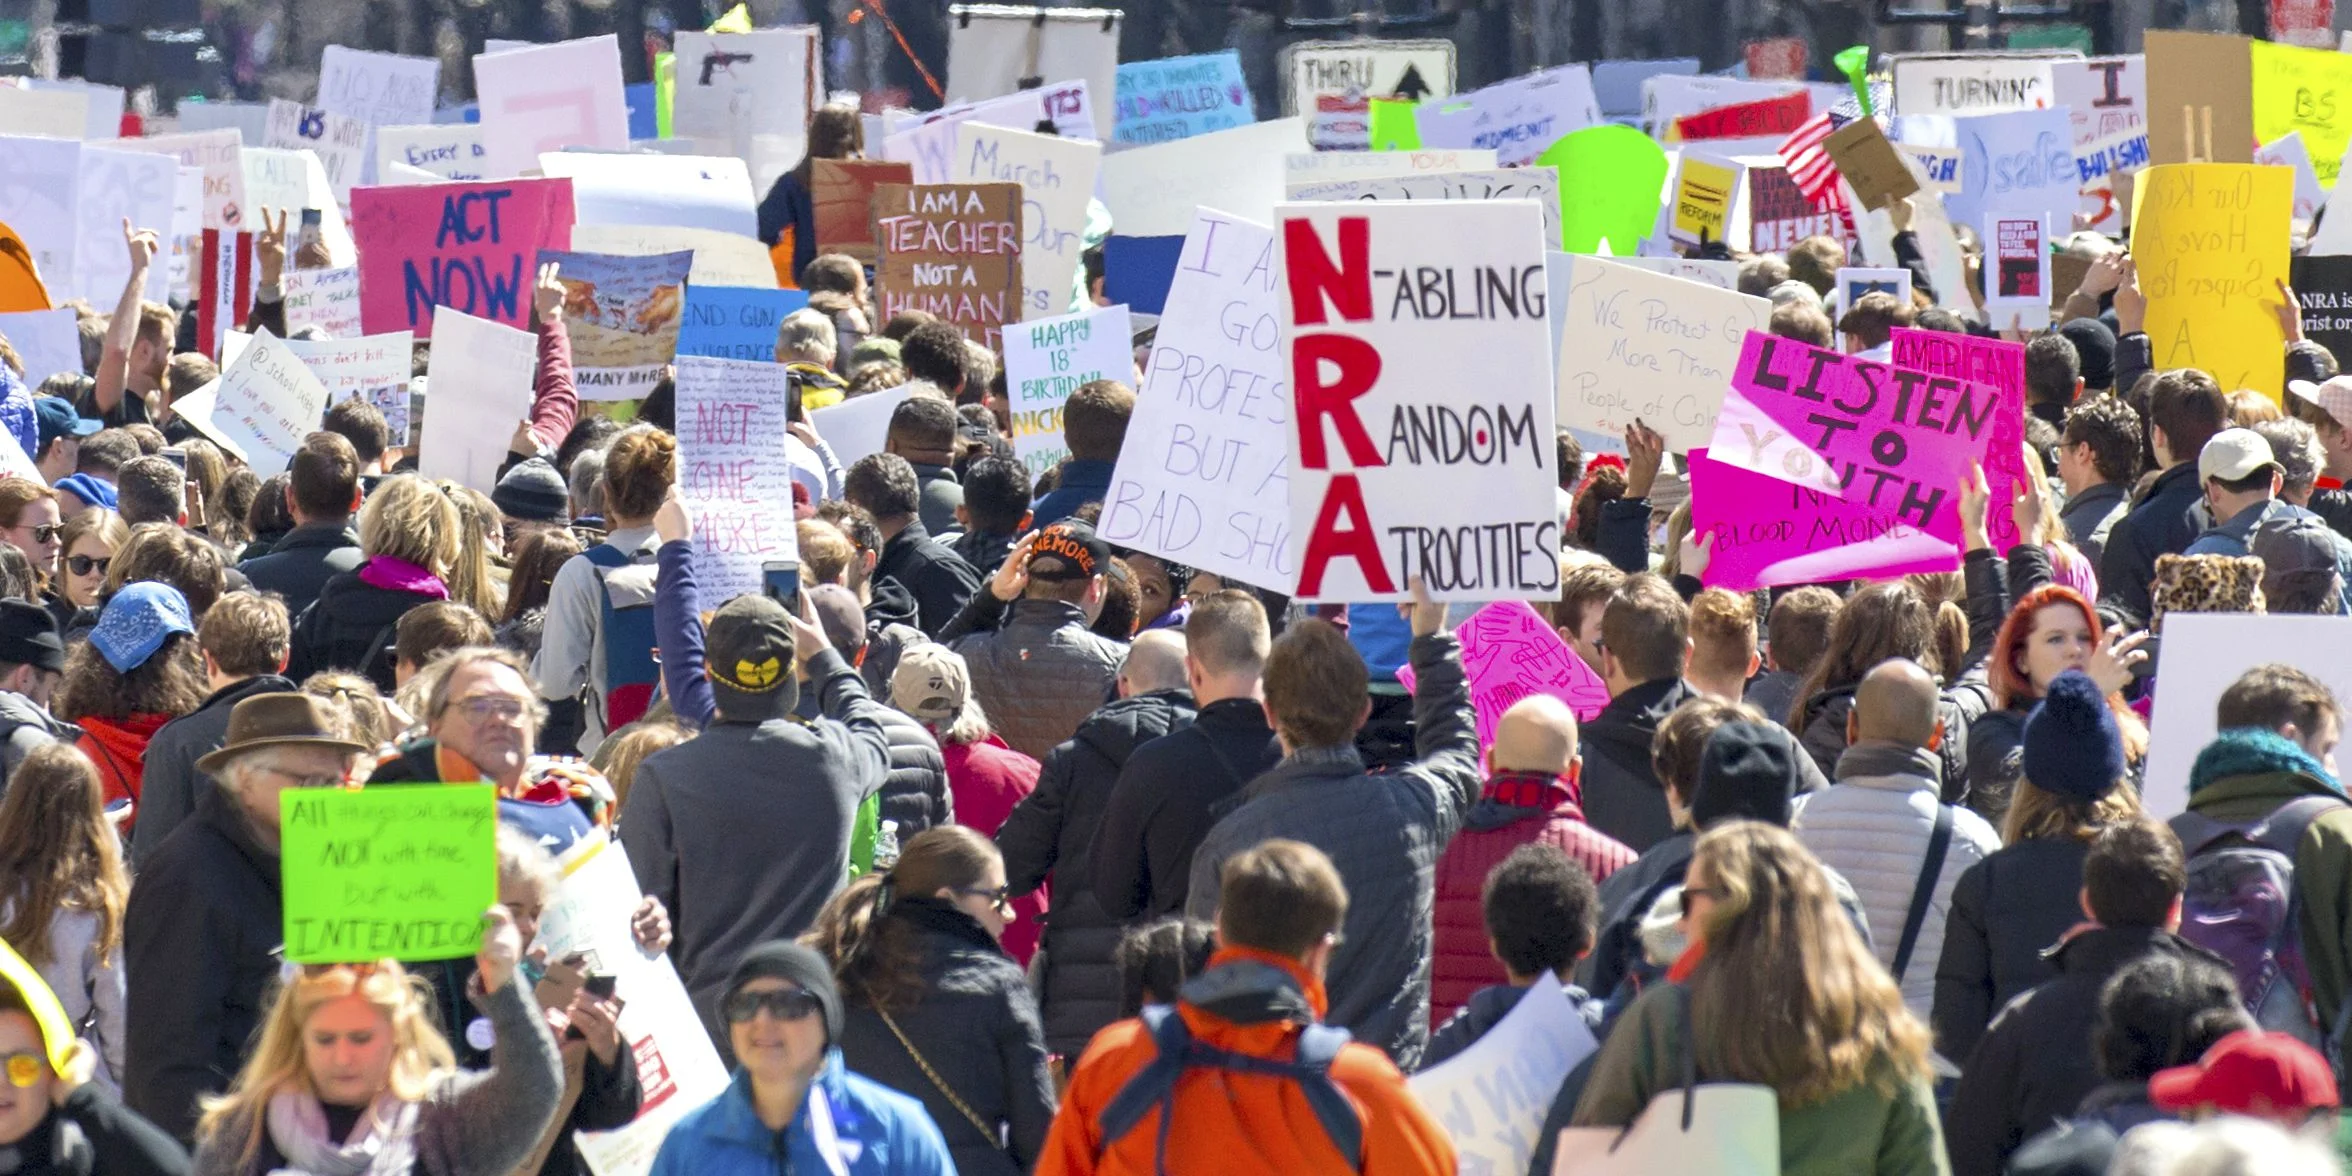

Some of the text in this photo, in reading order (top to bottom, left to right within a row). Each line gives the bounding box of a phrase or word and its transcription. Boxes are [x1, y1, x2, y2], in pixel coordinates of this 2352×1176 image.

[1303, 58, 1376, 89] THRU
[1932, 76, 2041, 109] TURNIN
[2088, 61, 2133, 108] I
[2294, 87, 2336, 121] BS
[970, 137, 1061, 189] March
[1339, 152, 1390, 168] DOES
[1410, 152, 1460, 169] YOUR
[1993, 131, 2078, 194] safe
[435, 188, 512, 249] ACT
[907, 190, 985, 215] I AM A
[878, 214, 1021, 255] TEACHER
[1184, 218, 1231, 278] I
[403, 253, 522, 327] NOW
[912, 262, 978, 288] NOT A
[739, 303, 776, 327] GUN
[885, 290, 1006, 324] HUMAN
[1592, 289, 1630, 330] We
[1639, 297, 1711, 340] Protect
[2301, 293, 2339, 309] NRA
[334, 346, 358, 363] don't
[365, 347, 385, 362] kill
[1031, 317, 1091, 350] HAPPY
[1605, 337, 1662, 372] More
[576, 371, 627, 385] MANY
[1896, 336, 2020, 395] AMERICAN
[1293, 333, 1543, 471] RANDOM
[1572, 370, 1634, 417] People
[1642, 394, 1665, 416] of
[1751, 338, 2000, 442] LISTEN
[696, 400, 760, 446] NOT
[1806, 410, 1908, 467] TO
[1165, 423, 1250, 483] BUT
[694, 458, 759, 504] ONE
[1739, 421, 1948, 530] YOUTH
[693, 511, 777, 555] MORE
[1105, 480, 1202, 552] BAD
[1295, 472, 1560, 599] ATROCITIES
[1715, 519, 1795, 552] BLOOD
[290, 799, 328, 828] All
[320, 838, 372, 869] NOT
[382, 841, 417, 865] with
[291, 917, 496, 957] INTENTION
